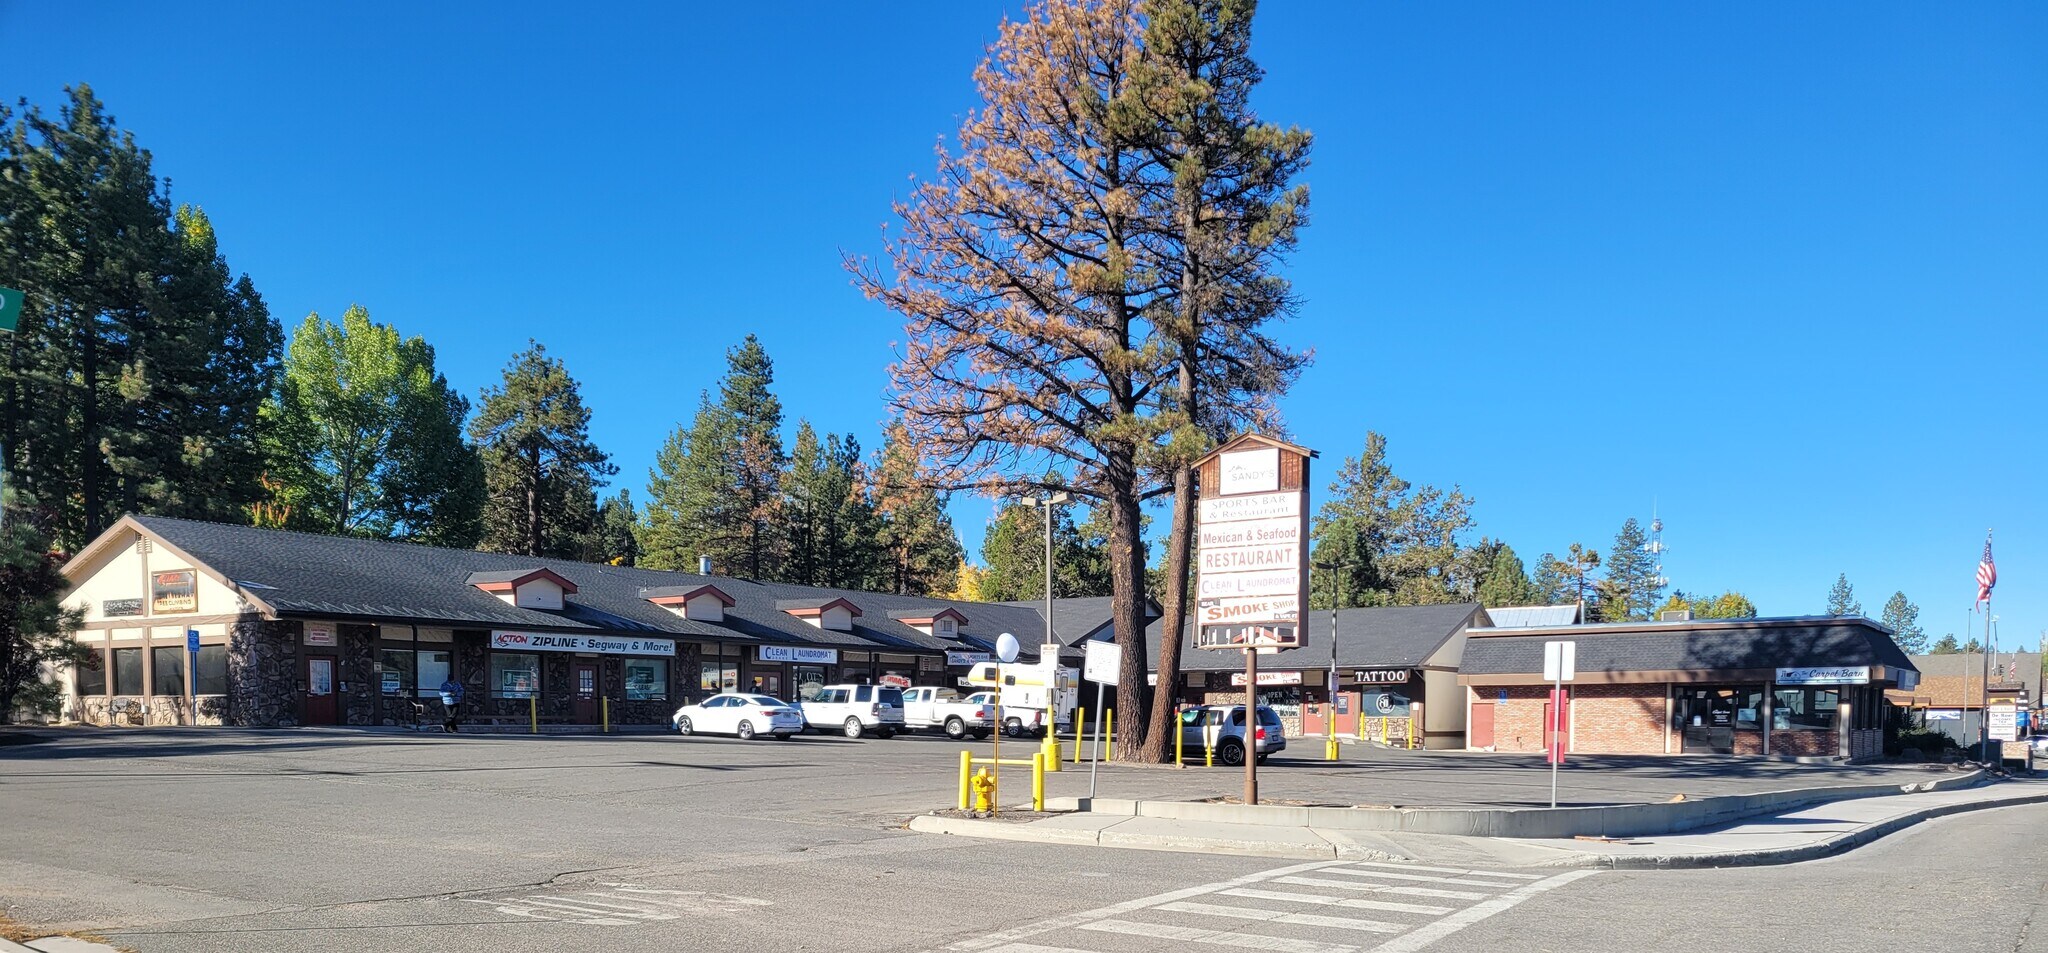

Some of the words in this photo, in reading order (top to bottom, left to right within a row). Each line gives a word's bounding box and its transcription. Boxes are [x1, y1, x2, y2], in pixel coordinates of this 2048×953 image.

[1231, 469, 1275, 482] SANDY'S
[1212, 497, 1258, 510] SPORTS
[1262, 495, 1286, 505] BAR
[1222, 506, 1289, 519] Restaurant
[1203, 532, 1243, 545] Mexican
[1246, 529, 1253, 541] &
[1257, 526, 1297, 540] Seafood
[1206, 548, 1292, 568] RESTAURANT
[1202, 580, 1232, 594] CLEAN
[1237, 576, 1296, 592] LAUNDROMAT
[1207, 602, 1270, 620] SMOKE
[1272, 600, 1295, 610] SHOP
[497, 634, 528, 645] ACTION
[532, 636, 579, 648] ZIPLINE
[587, 640, 628, 652] Segway
[632, 641, 639, 650] &
[643, 641, 673, 652] More!
[765, 646, 788, 660] CLEAN
[792, 648, 832, 661] LAUNDROMAT
[1237, 673, 1277, 685] SOKE
[1355, 670, 1405, 682] TATTOO
[1809, 669, 1839, 679] Carpet
[1841, 668, 1864, 678] Barn
